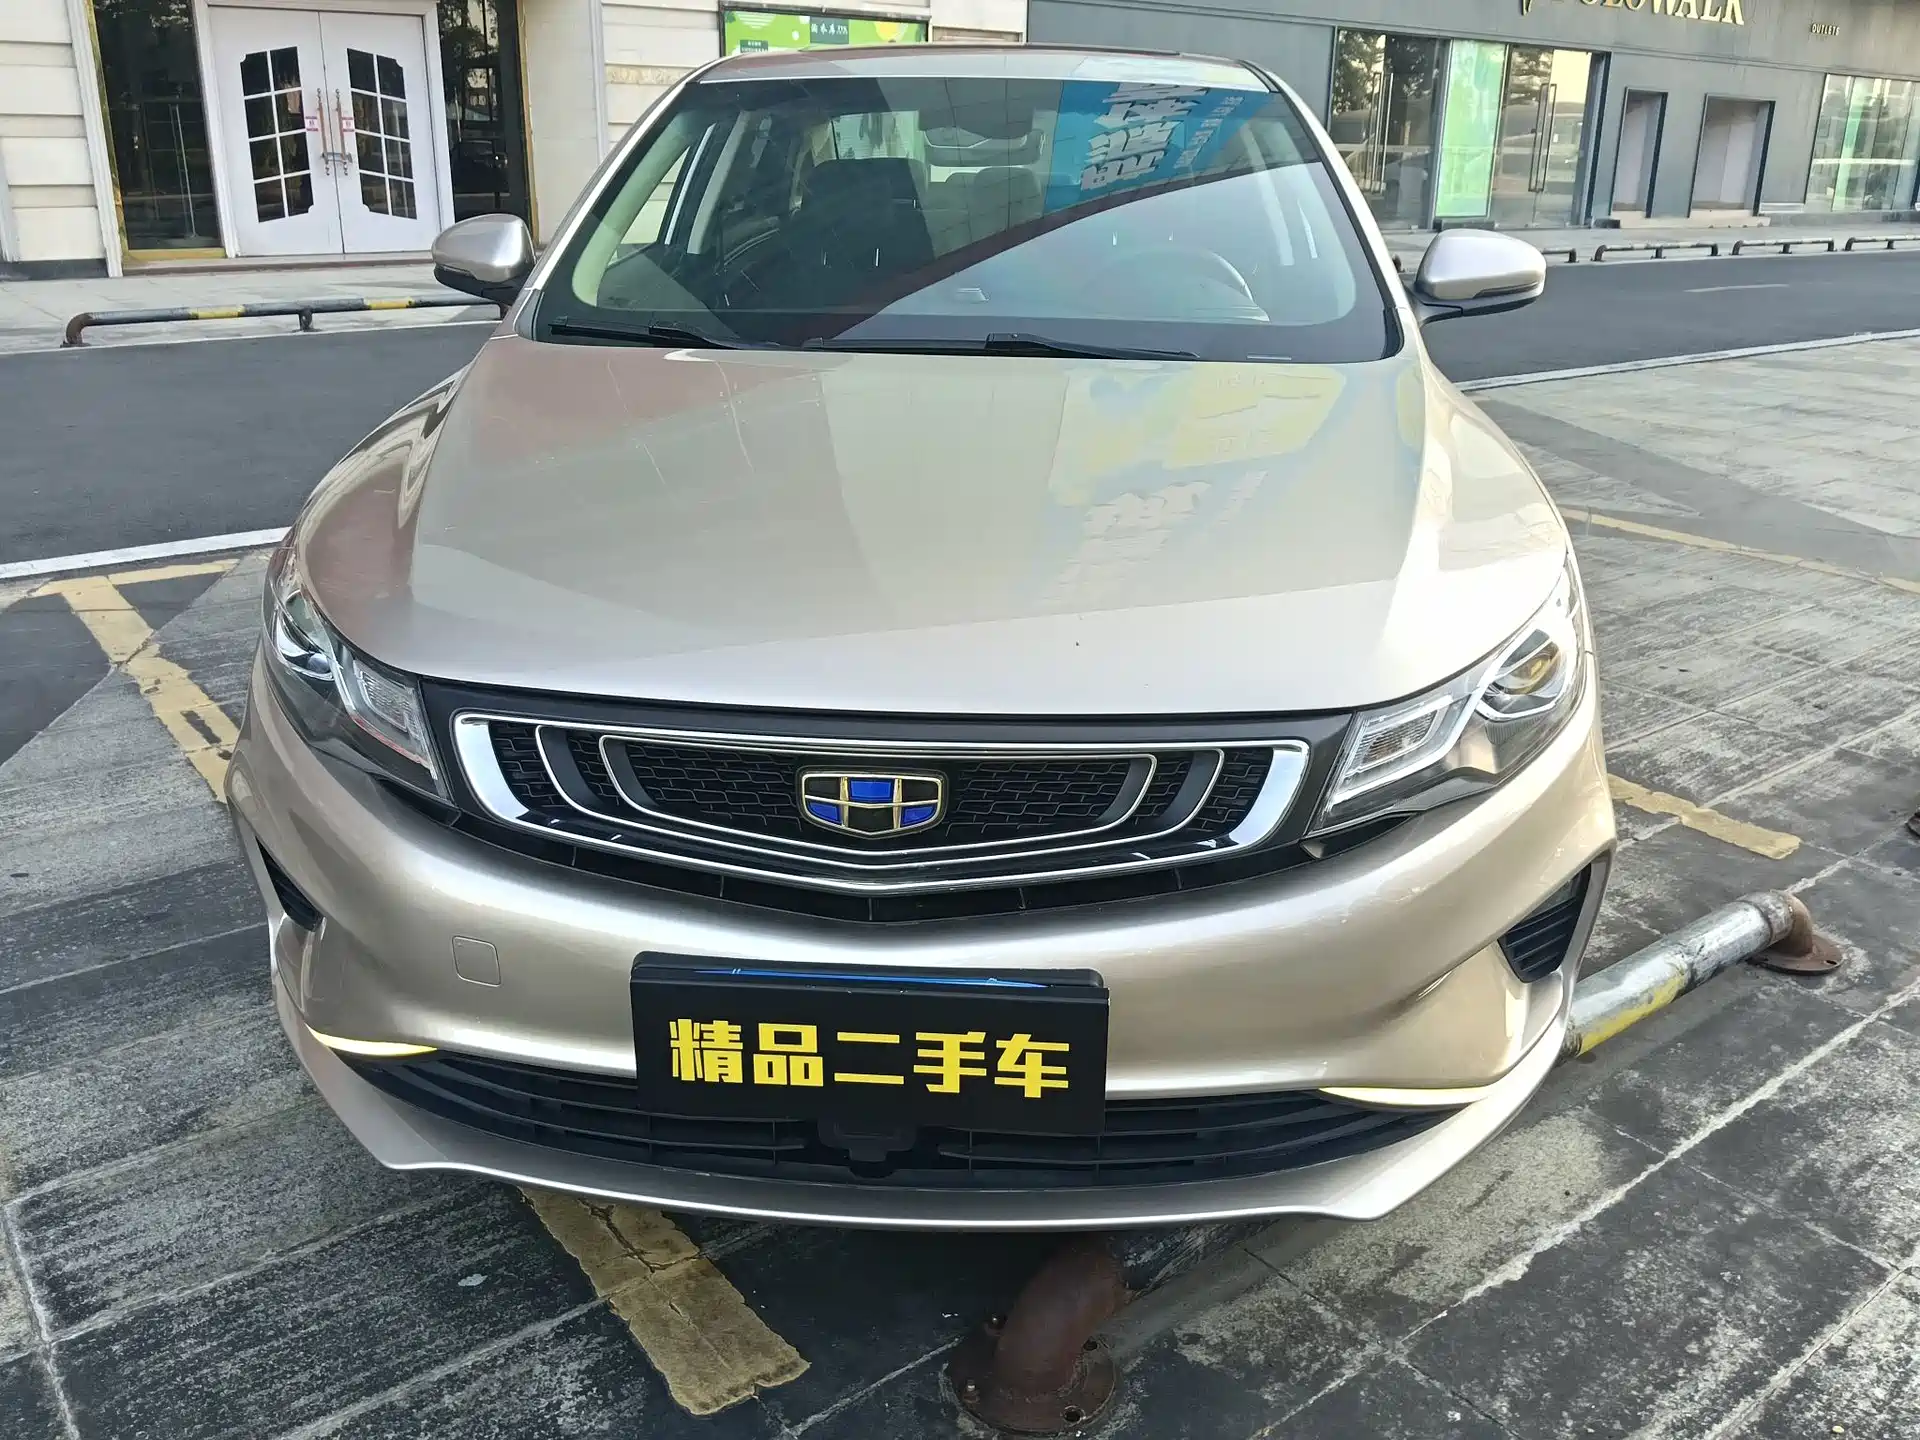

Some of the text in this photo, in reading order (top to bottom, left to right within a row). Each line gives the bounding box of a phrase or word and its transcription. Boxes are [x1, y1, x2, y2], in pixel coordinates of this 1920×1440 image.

[1811, 23, 1840, 35] OUTLETS
[669, 1018, 1070, 1098] 精品二手车
